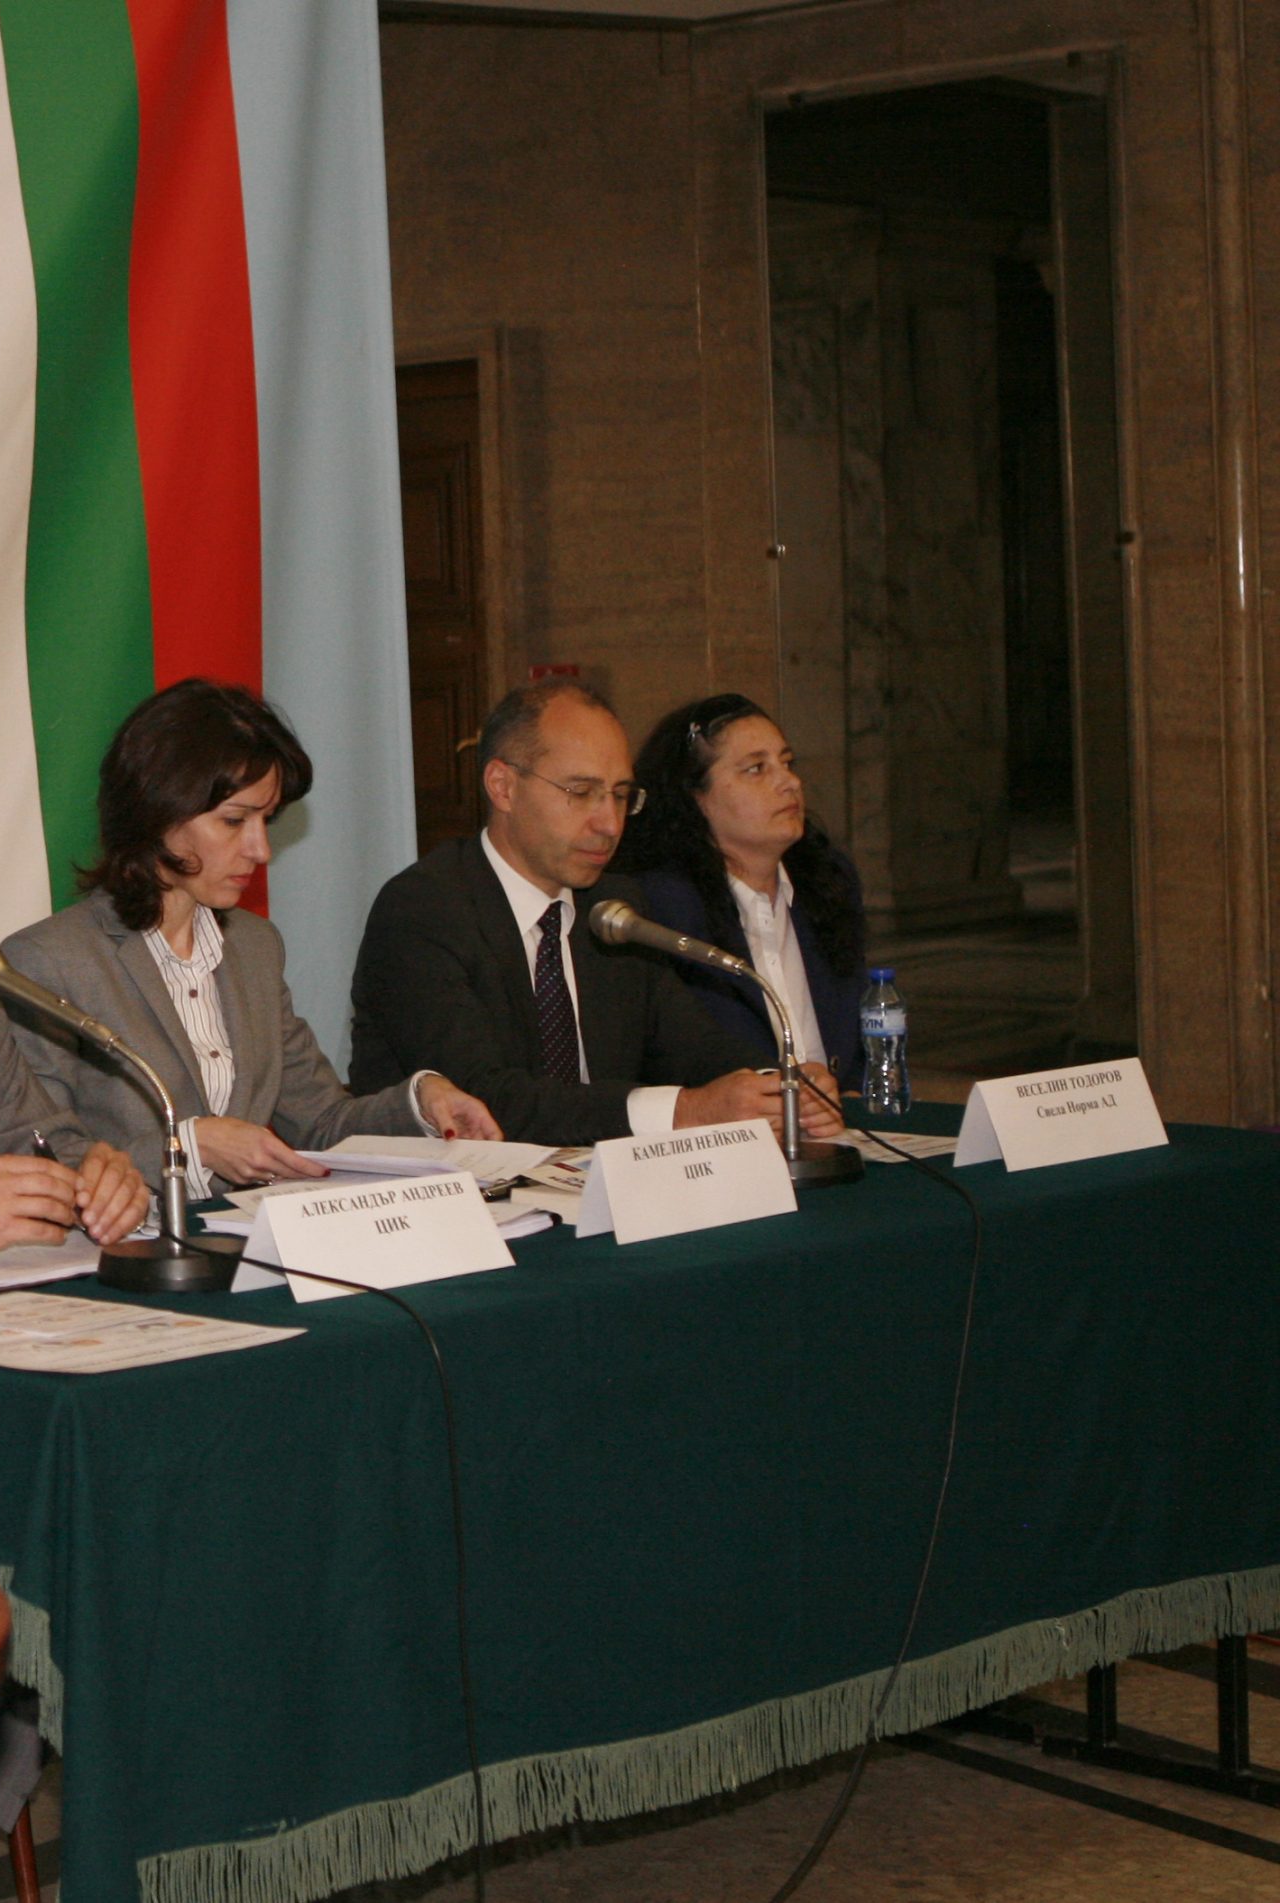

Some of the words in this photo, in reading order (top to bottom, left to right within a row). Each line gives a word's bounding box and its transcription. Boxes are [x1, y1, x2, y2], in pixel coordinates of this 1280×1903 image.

[1016, 1079, 1068, 1098] ВЕСЕЛИН
[1069, 1070, 1122, 1089] ТОДОРОВ
[632, 1138, 694, 1162] КАМЕЛИЯ
[695, 1128, 758, 1151] НЕЙКОВА
[684, 1161, 714, 1180] ЦИК
[301, 1190, 397, 1219] АЛЕКСАНДЪР
[402, 1181, 464, 1203] АНДРЕЕВ
[374, 1215, 412, 1234] ЦИК
